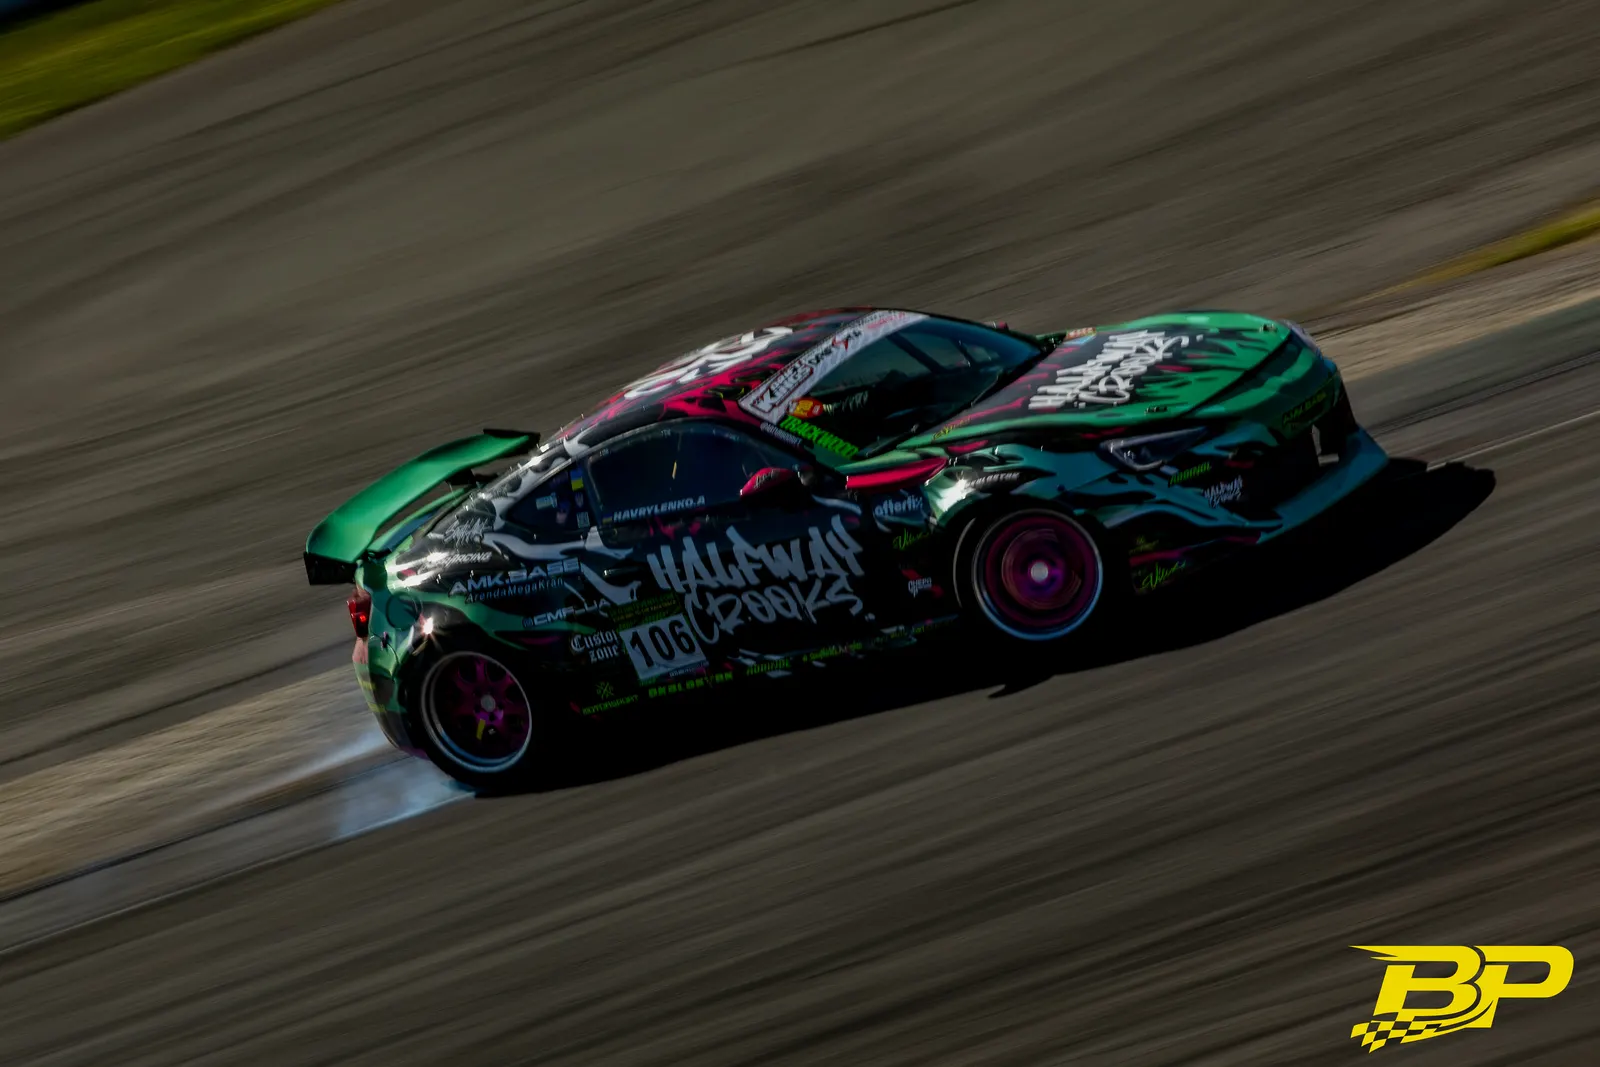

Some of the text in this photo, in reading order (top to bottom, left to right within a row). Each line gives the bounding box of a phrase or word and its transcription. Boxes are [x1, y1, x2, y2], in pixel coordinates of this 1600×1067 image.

[646, 514, 865, 593] HALFWAY
[630, 619, 696, 668] 106
[684, 577, 865, 645] CROOKS
